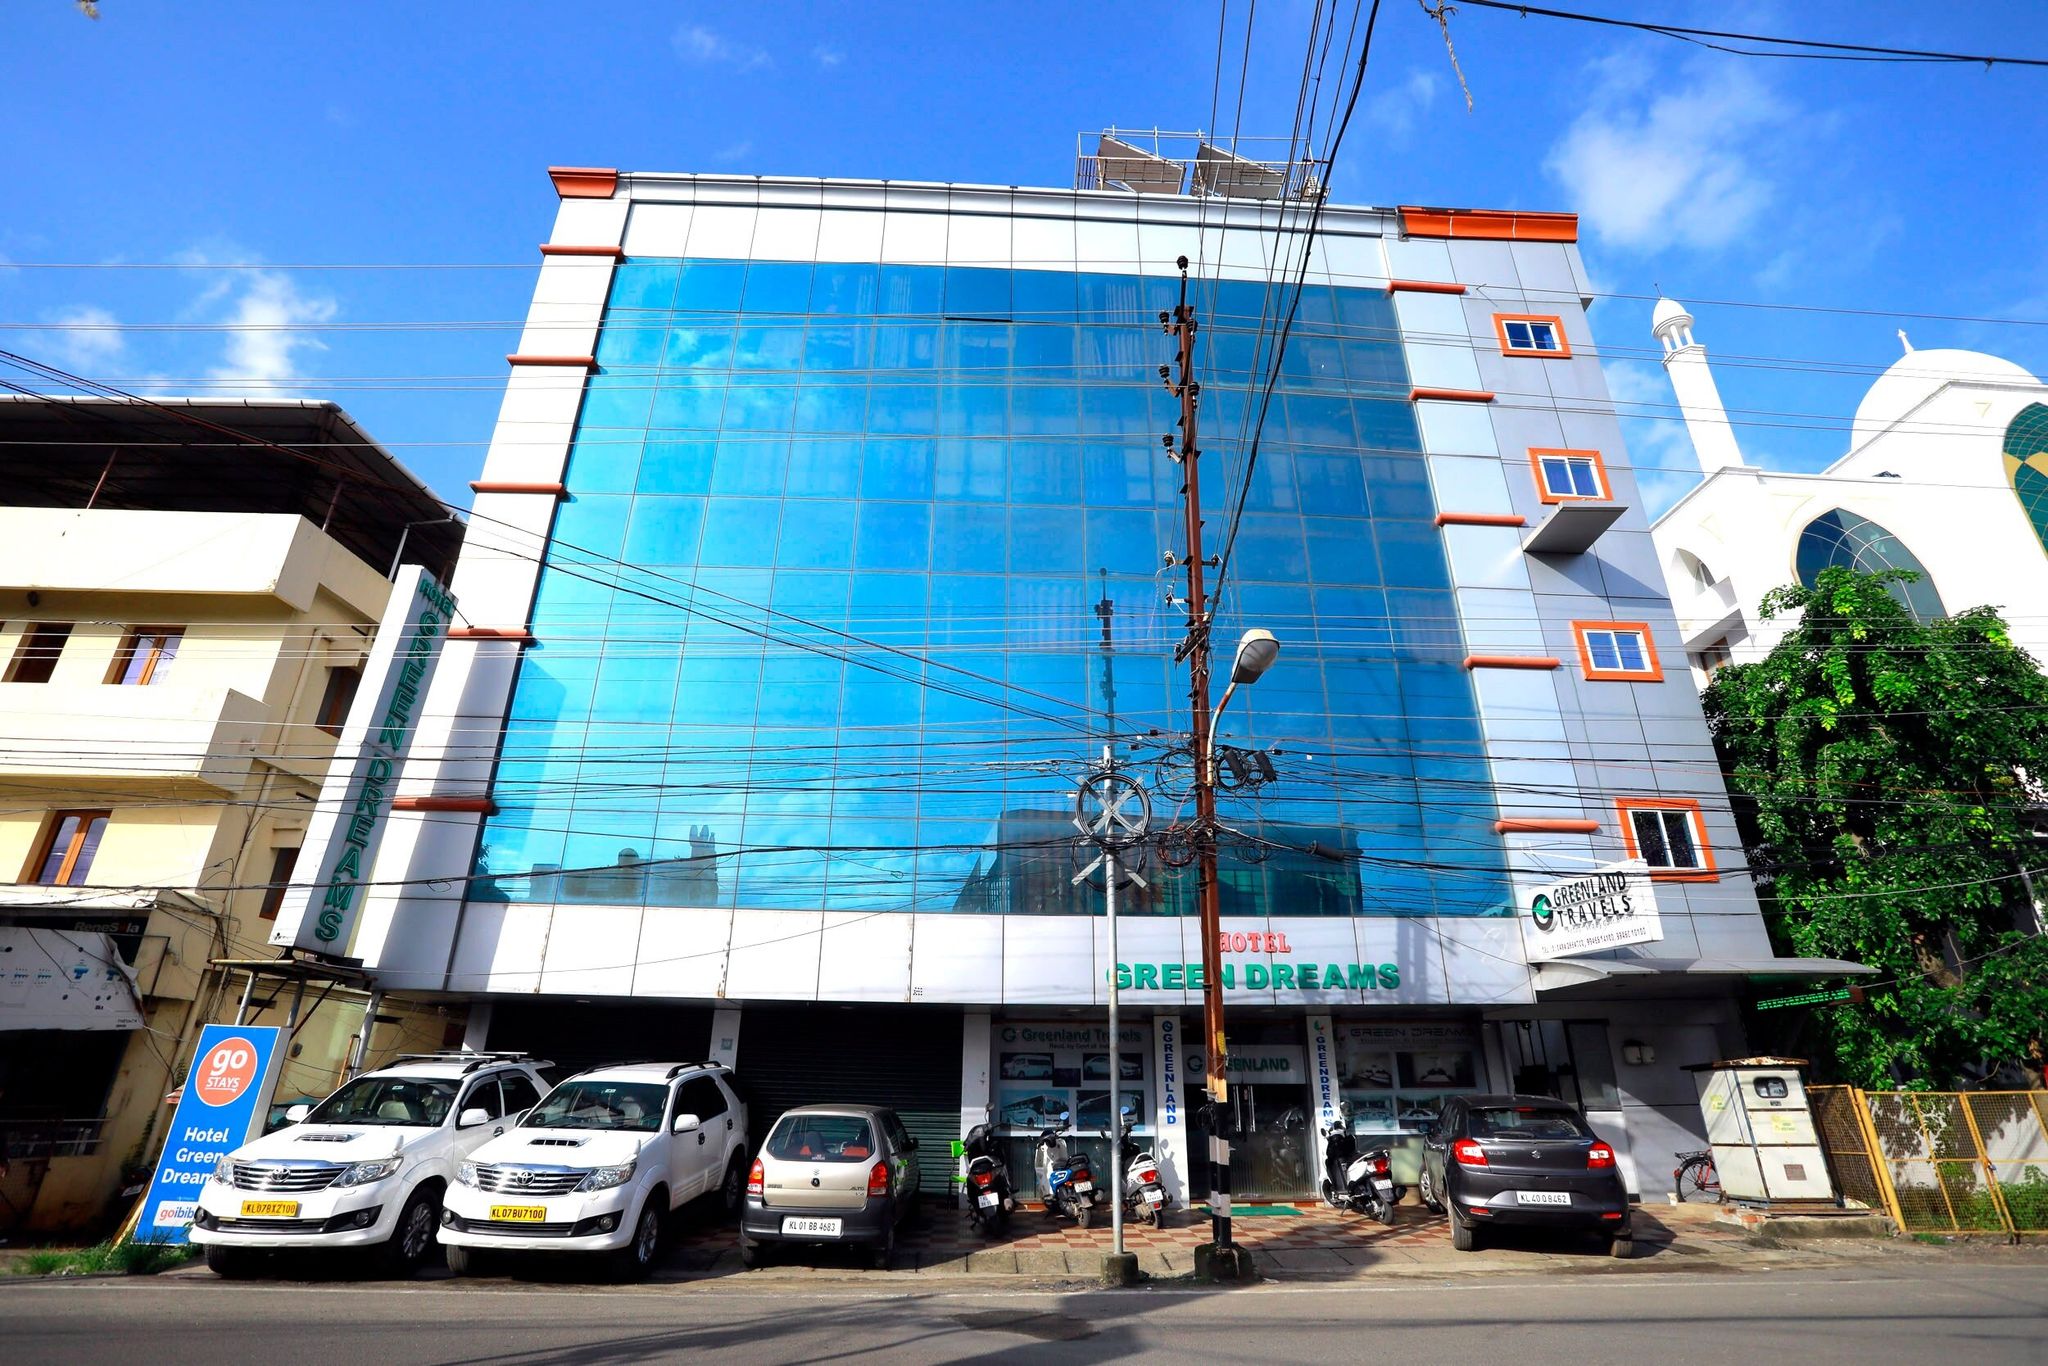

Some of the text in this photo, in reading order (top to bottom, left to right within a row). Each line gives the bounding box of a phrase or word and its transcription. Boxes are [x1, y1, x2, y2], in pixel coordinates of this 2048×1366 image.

[419, 579, 453, 618] HOTEL
[379, 611, 440, 751] GREEN
[315, 754, 392, 942] DREAMS
[1553, 872, 1627, 907] GREENLAND
[1557, 895, 1632, 927] TRAVELS
[1220, 932, 1292, 953] HOTEL
[1106, 963, 1400, 990] GREEN DREAMS
[1022, 1028, 1090, 1043] Greenland
[1095, 1029, 1142, 1041] Trvels
[210, 1049, 248, 1076] go
[1226, 1057, 1290, 1072] EENLAND
[206, 1077, 240, 1088] STAYS
[1163, 1034, 1177, 1124] GREENLAND
[184, 1127, 229, 1143] Hotel
[176, 1149, 224, 1163] Green
[161, 1168, 213, 1184] Dream
[160, 1207, 195, 1220] goibib
[789, 1221, 836, 1232] KL 01 BB 4683
